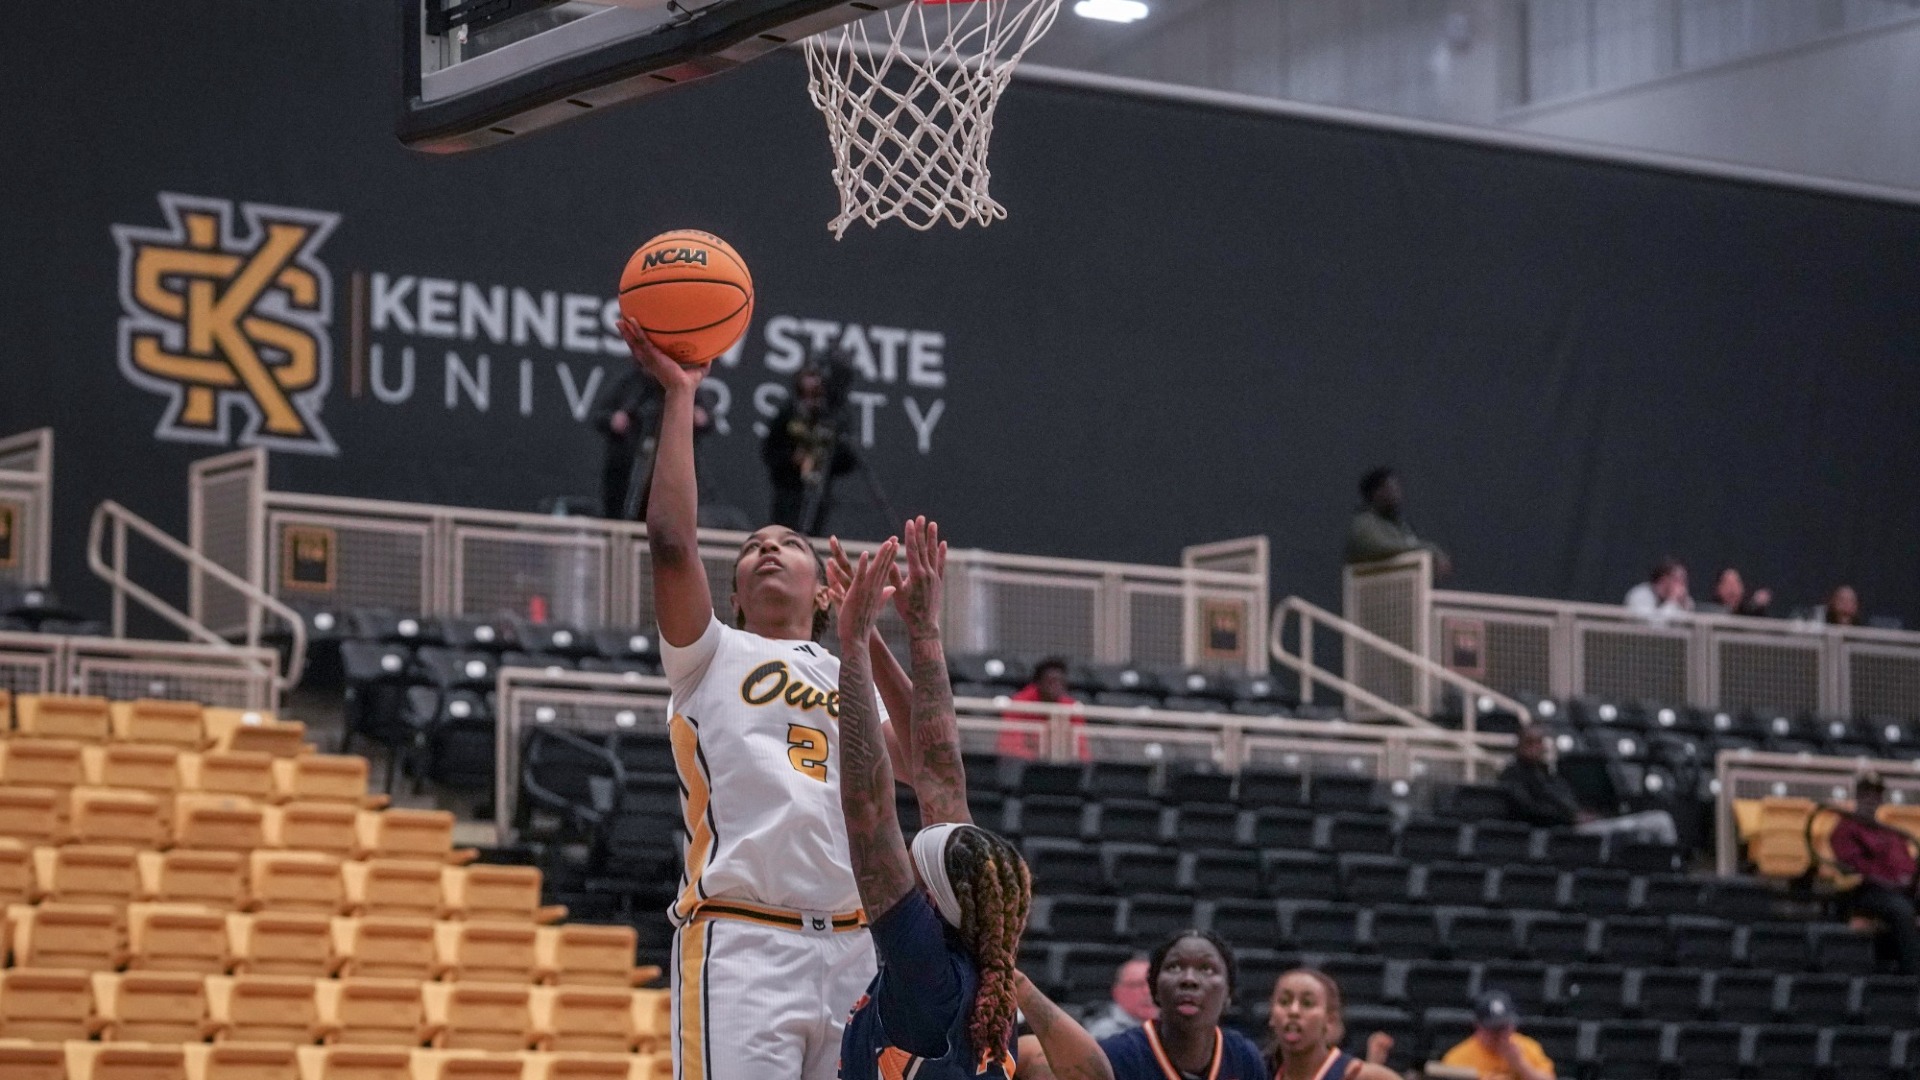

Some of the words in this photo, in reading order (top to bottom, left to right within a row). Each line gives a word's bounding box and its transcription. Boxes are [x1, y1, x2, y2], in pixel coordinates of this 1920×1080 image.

[641, 247, 709, 272] NCAA
[764, 316, 946, 388] STATE
[787, 723, 829, 783] 2
